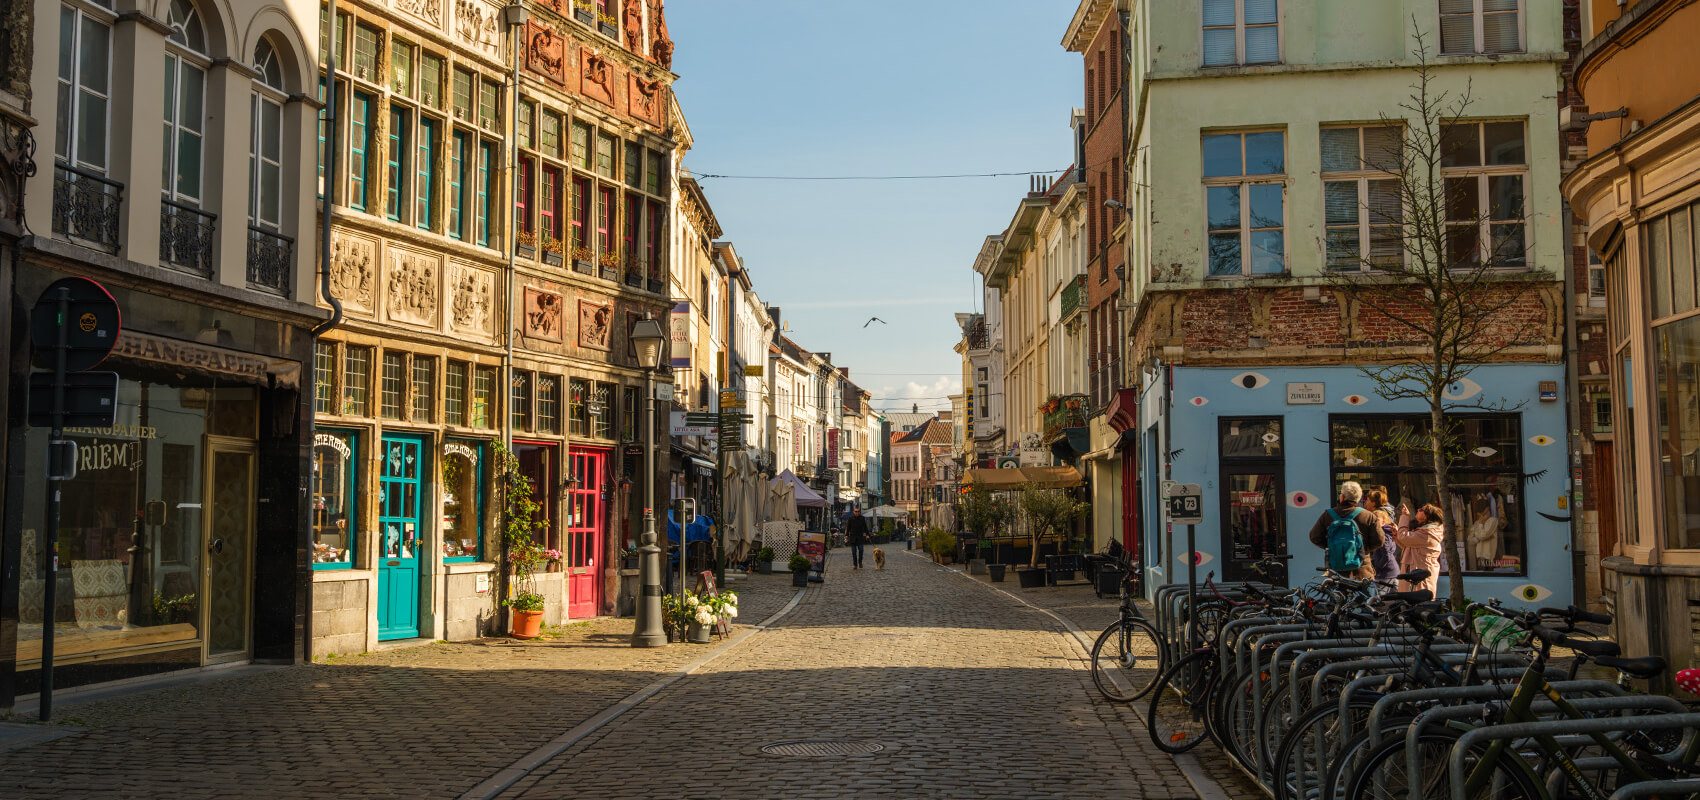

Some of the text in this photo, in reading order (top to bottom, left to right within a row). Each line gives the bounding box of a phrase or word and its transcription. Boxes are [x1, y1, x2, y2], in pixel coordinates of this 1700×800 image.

[114, 334, 268, 375] HANGPAPIER
[75, 438, 128, 471] RIEM
[1186, 499, 1195, 508] 73
[1555, 751, 1565, 760] DE
